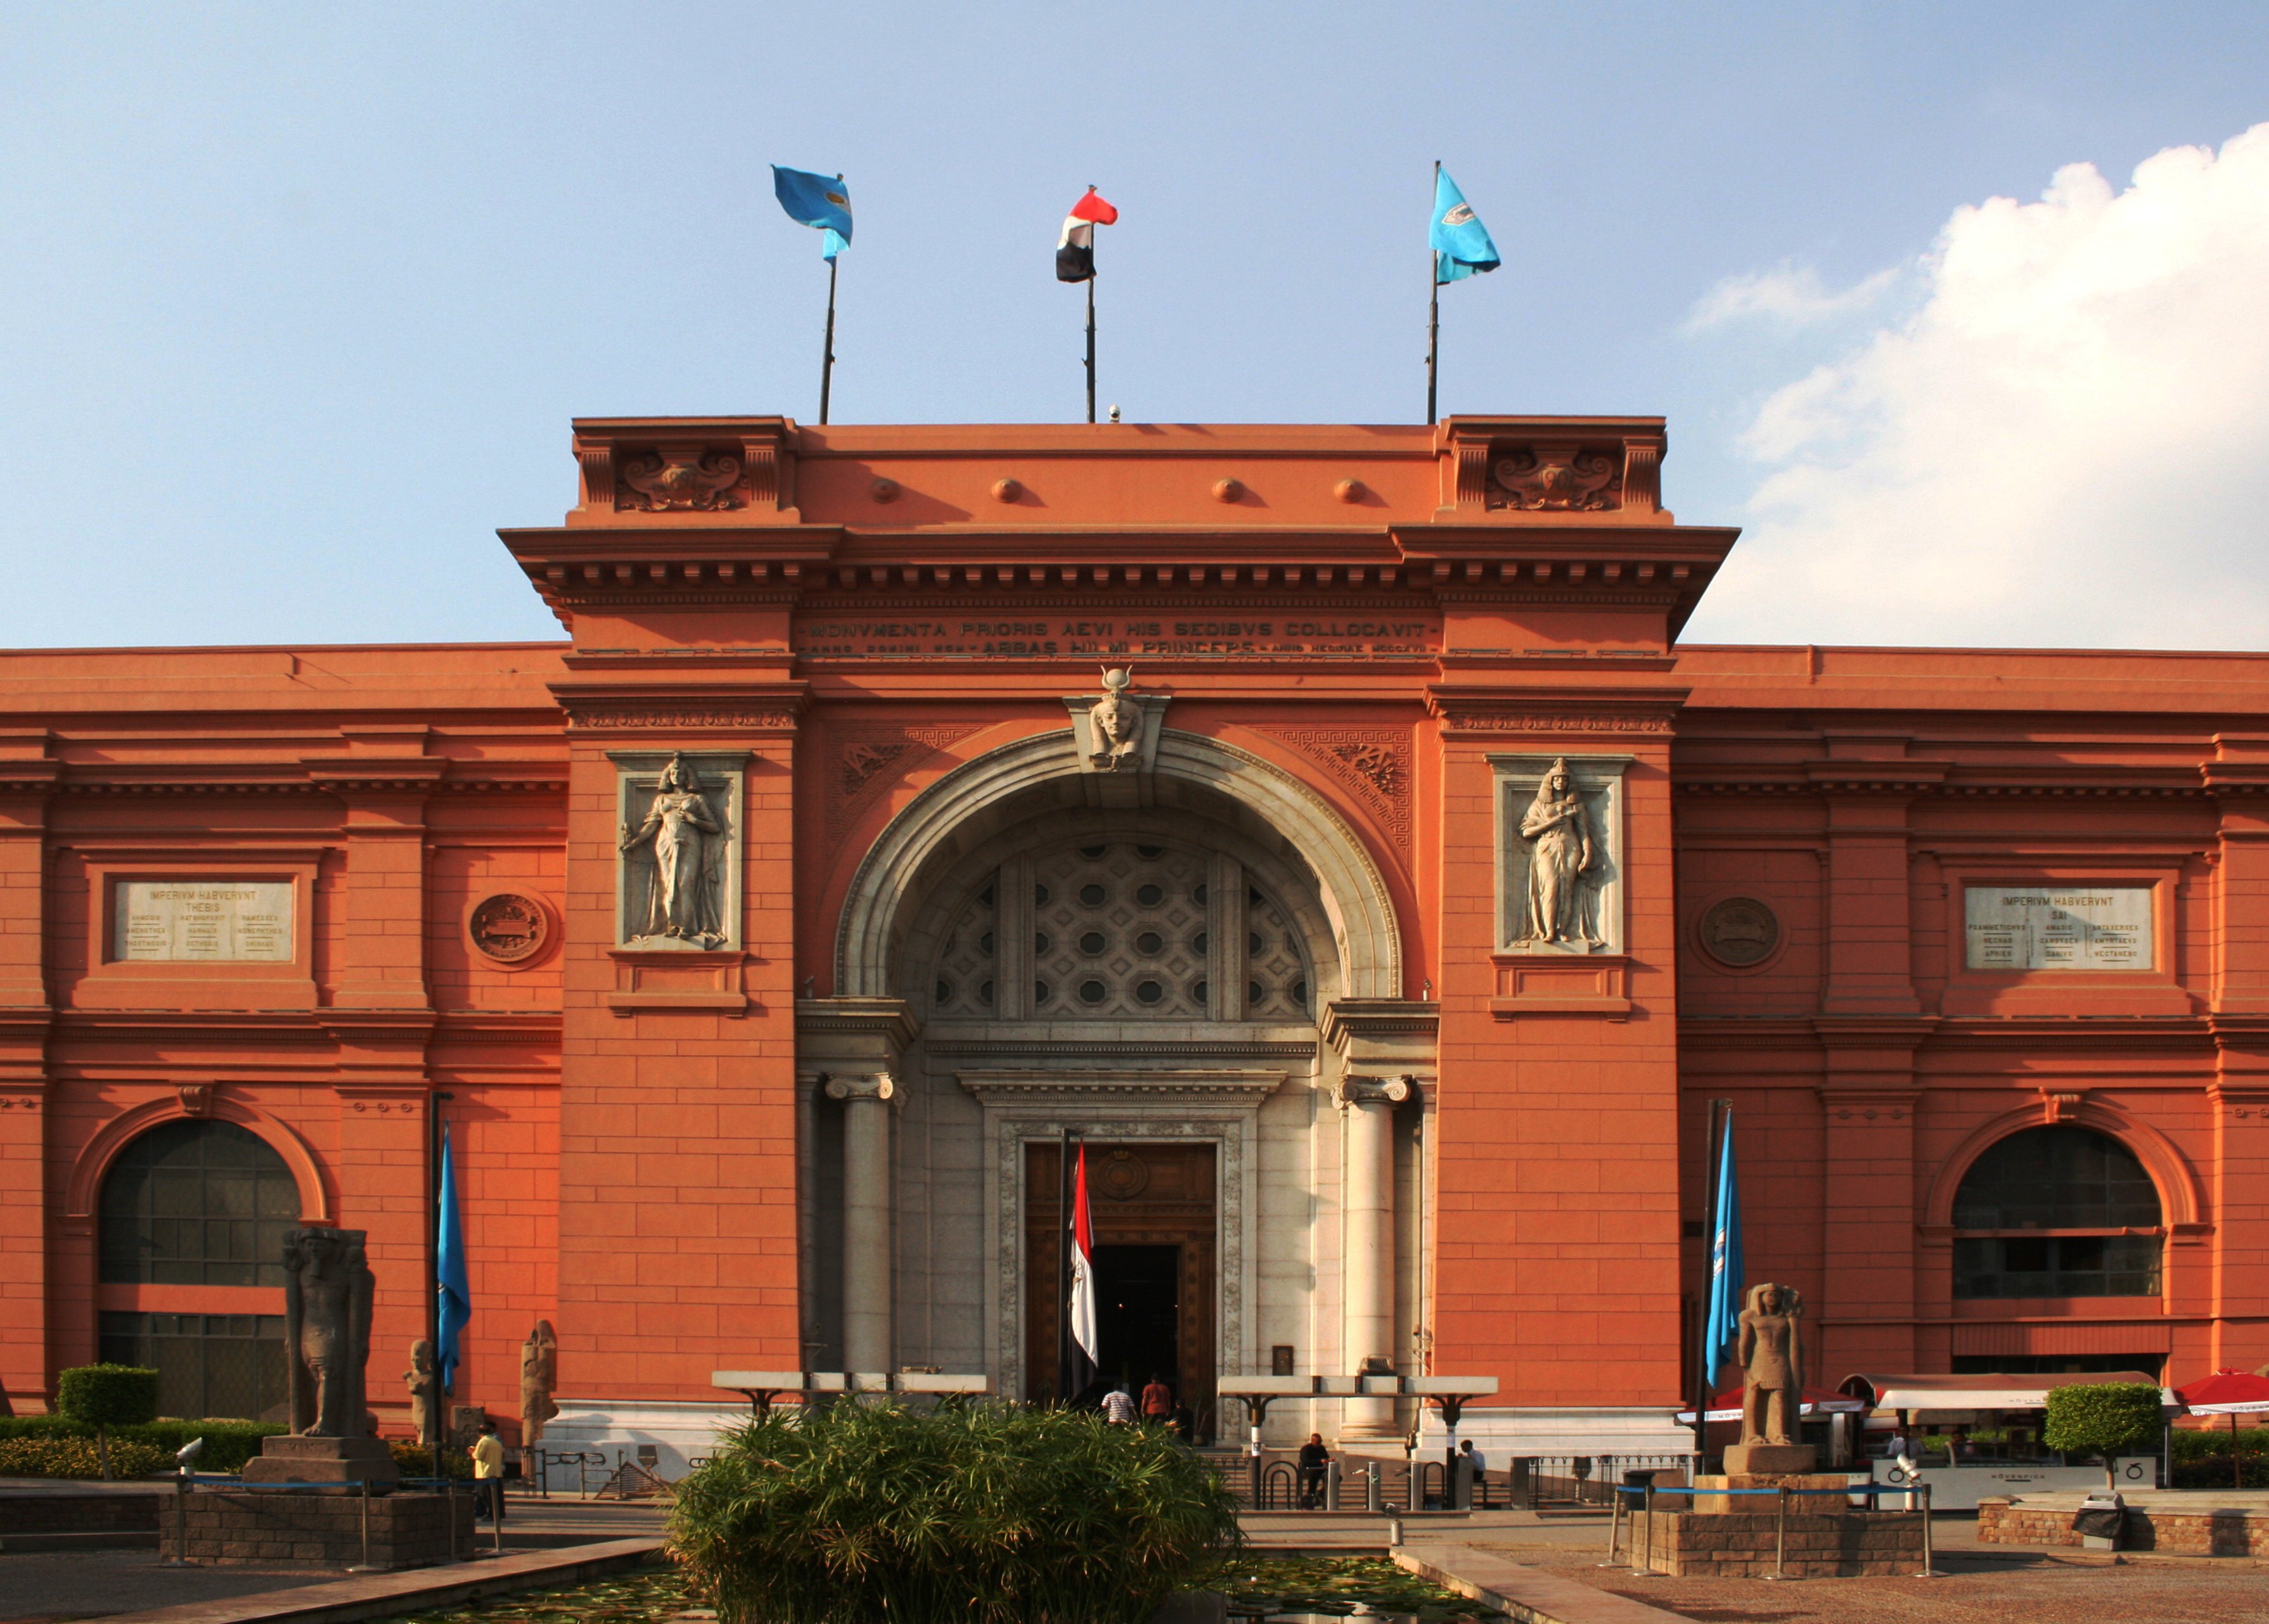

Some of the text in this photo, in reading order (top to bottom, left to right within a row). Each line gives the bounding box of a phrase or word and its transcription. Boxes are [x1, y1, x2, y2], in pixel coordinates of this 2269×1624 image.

[809, 623, 1425, 637] MONVMENTA PRIORIS AEVI HIS SEDIBVS COLLOCAVIT
[983, 641, 1058, 653] ABBAS
[1142, 641, 1255, 653] PRINCEPS
[150, 891, 257, 900] IMPERIVM HABVERVNT
[2003, 897, 2114, 906] IMPERIVM HABVERVNT
[186, 903, 220, 912] THEBIS
[2052, 911, 2067, 919] SAI
